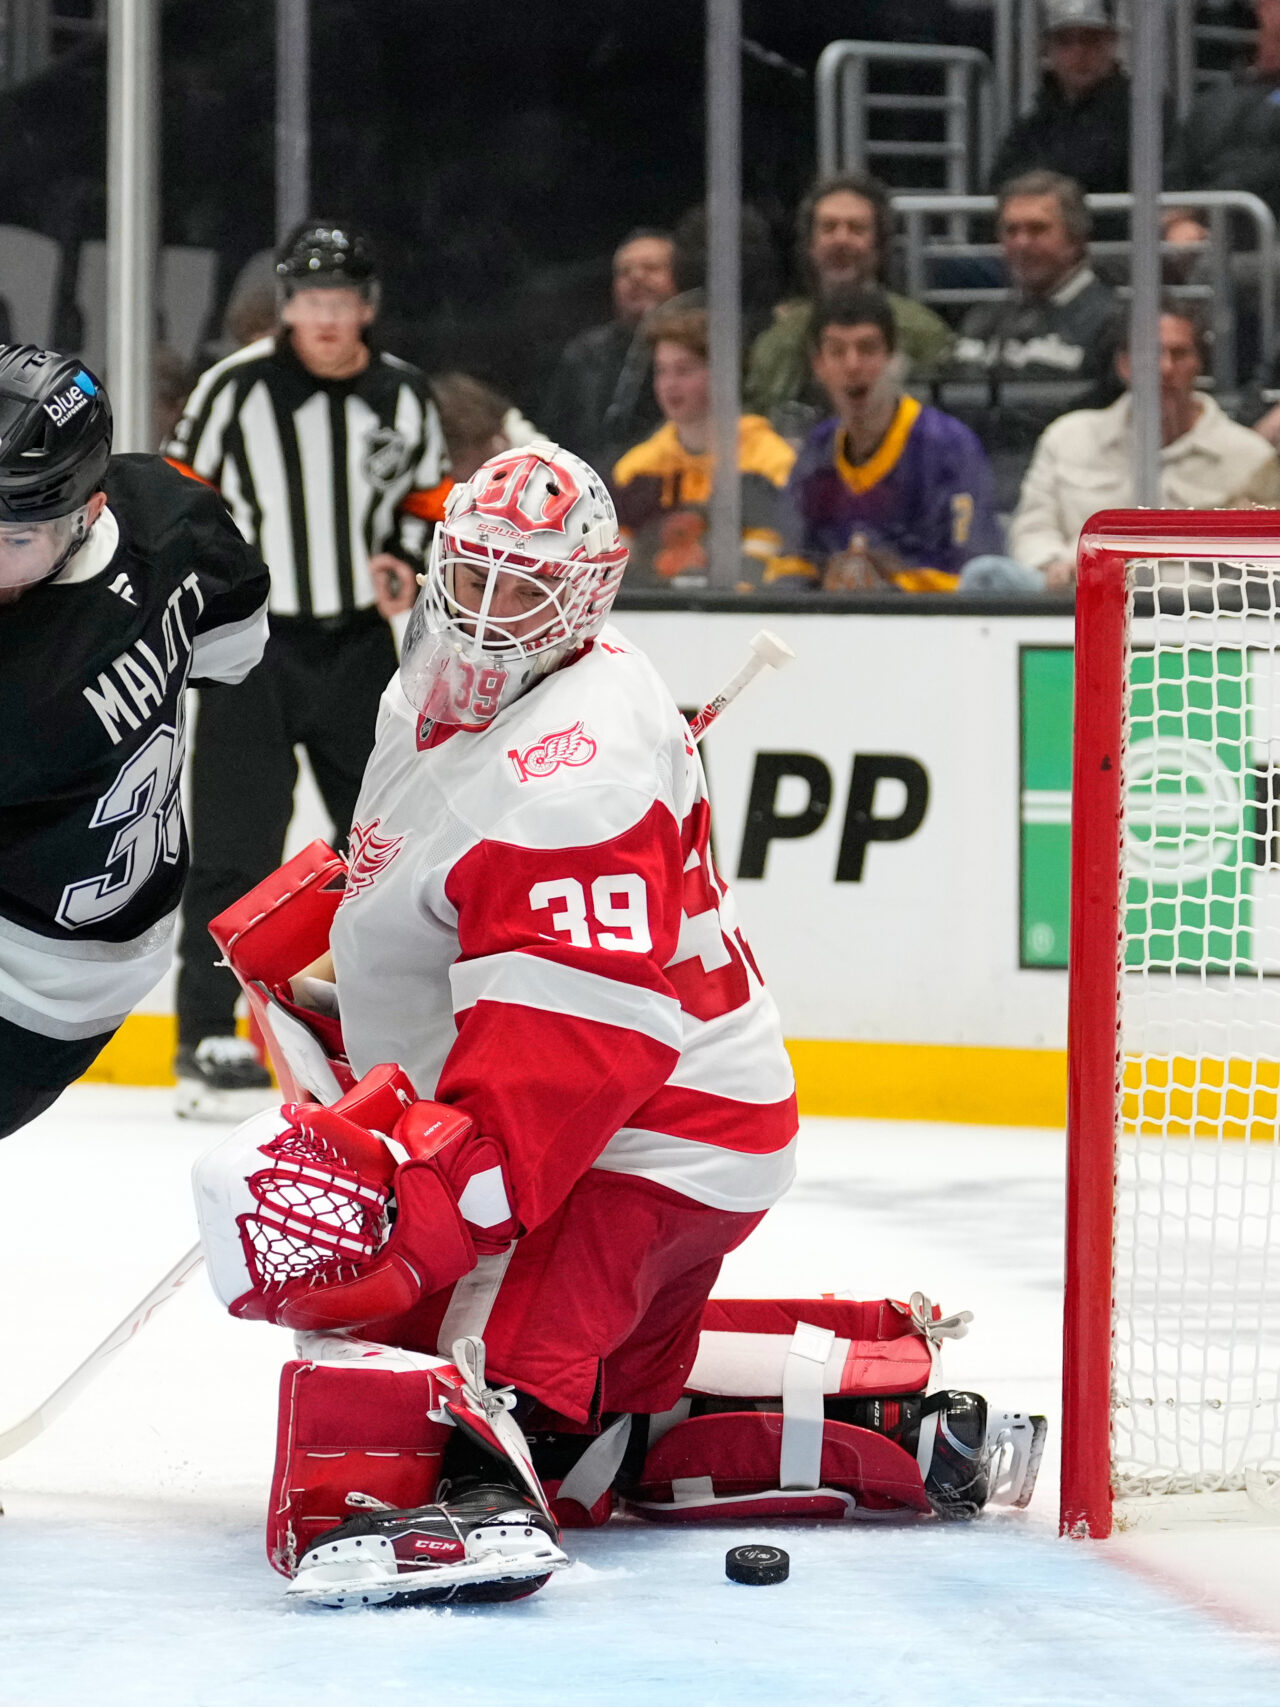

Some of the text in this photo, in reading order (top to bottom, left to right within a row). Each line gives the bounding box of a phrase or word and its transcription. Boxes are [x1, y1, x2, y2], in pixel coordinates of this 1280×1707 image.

[43, 385, 83, 422] blue
[56, 397, 88, 428] CALIFORNIA
[82, 571, 204, 746] MALOTT
[55, 722, 187, 931] 3
[528, 873, 653, 954] 39
[414, 1539, 457, 1552] CCM
